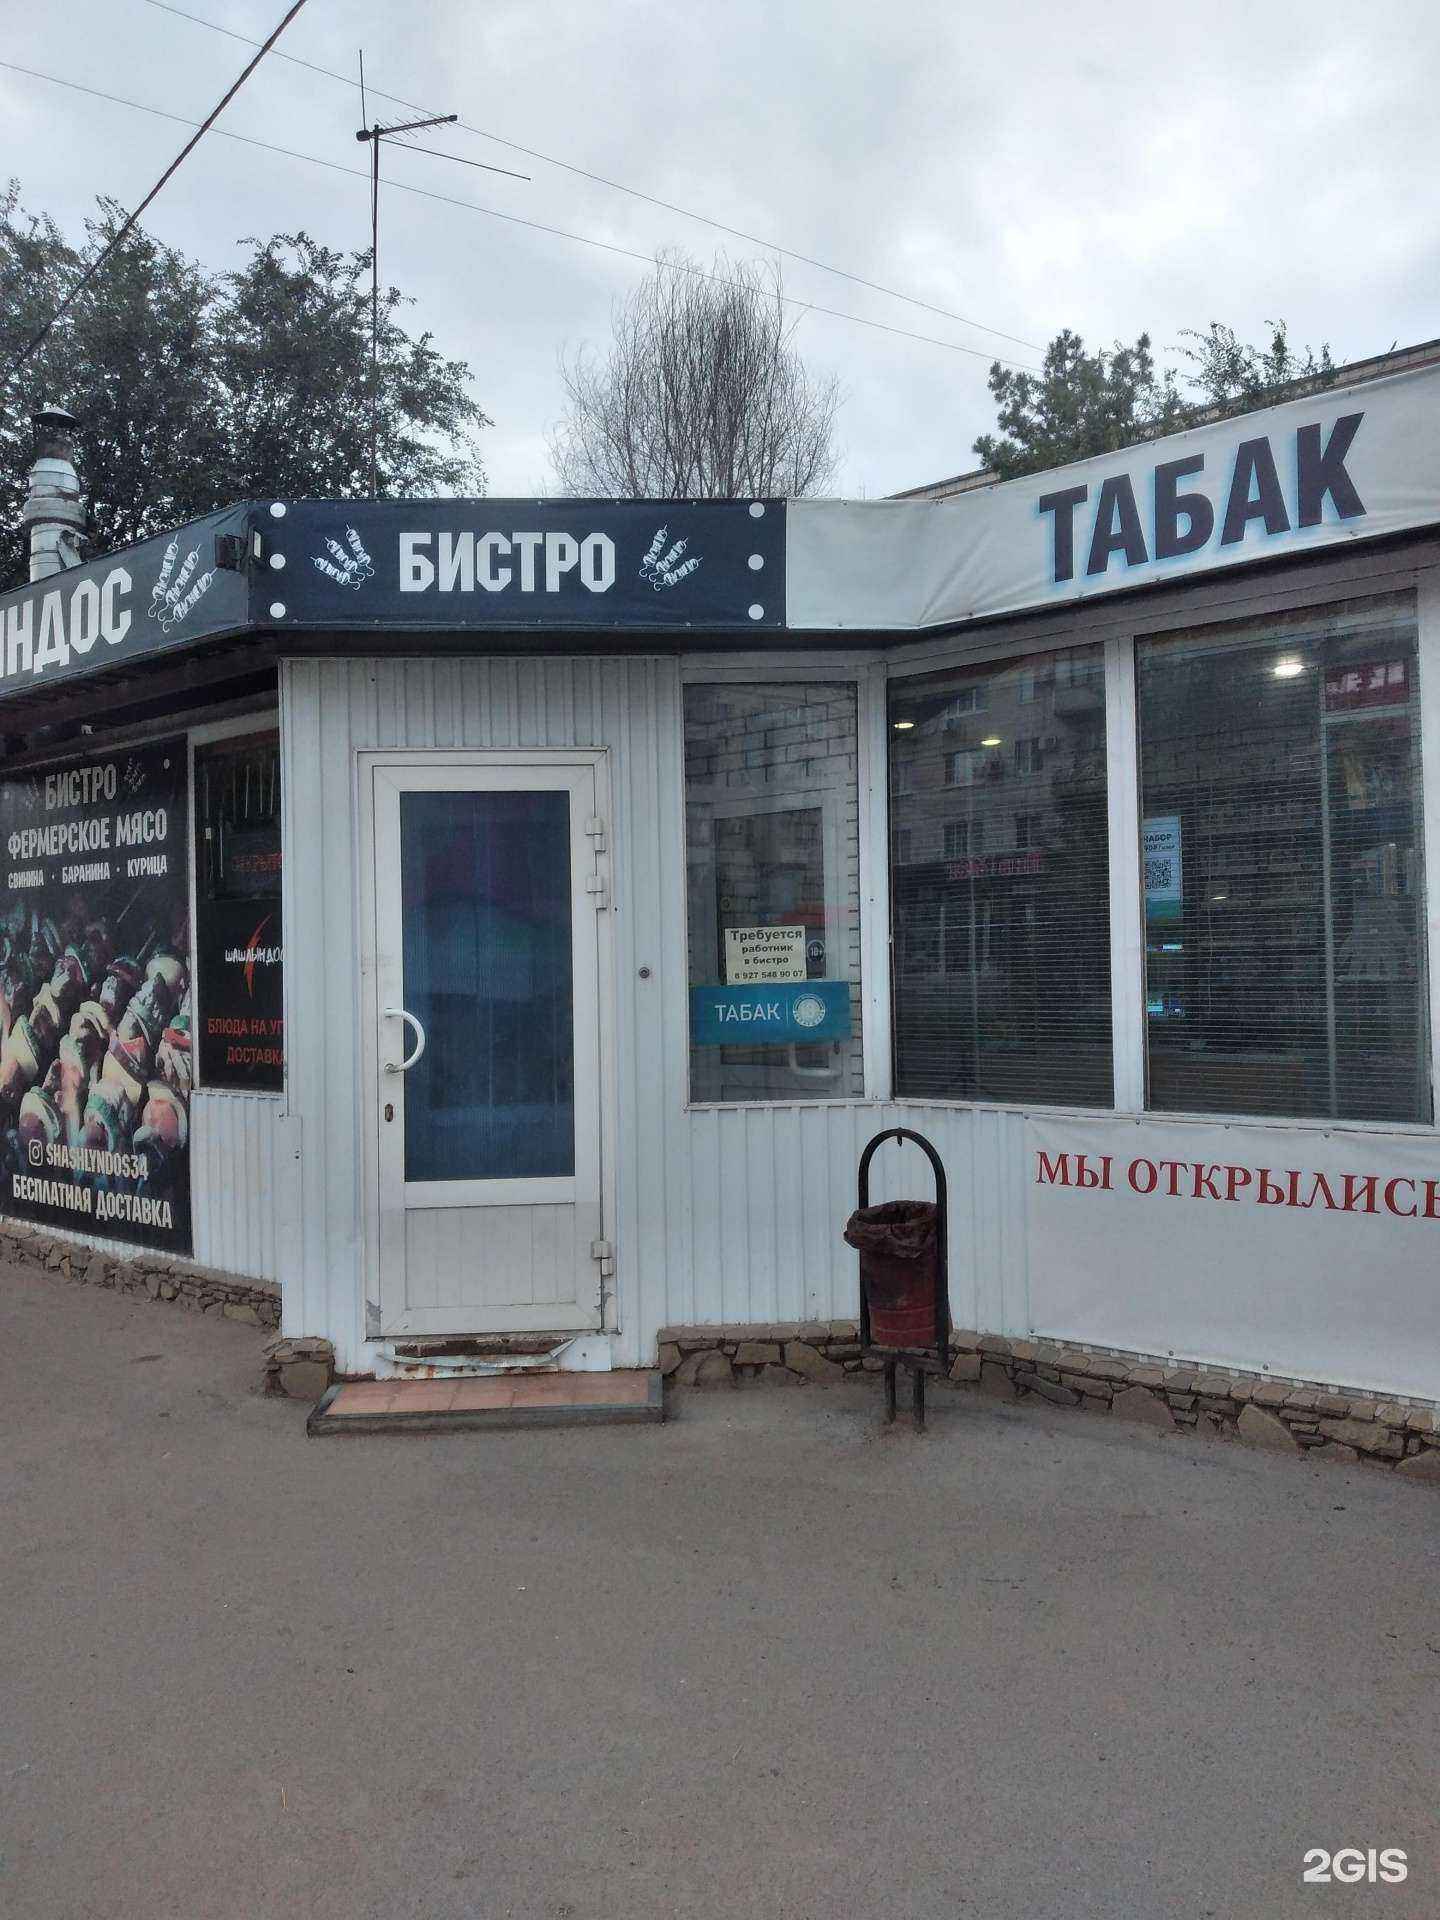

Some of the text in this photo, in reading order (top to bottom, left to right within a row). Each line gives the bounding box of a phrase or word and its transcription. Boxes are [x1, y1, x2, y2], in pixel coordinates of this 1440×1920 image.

[1039, 411, 1367, 583] ТАБАК
[399, 532, 616, 593] БИСТРО
[0, 567, 132, 678] НДОС
[45, 763, 117, 810] БИСТРО
[8, 808, 168, 860] ФЕРМЕРСКОЕ МЯСО
[8, 855, 168, 889] СВИНИНА БАРАНИНА КУРИЦА
[730, 929, 802, 943] Требуется
[742, 944, 793, 954] работник
[743, 972, 758, 980] 927
[753, 956, 789, 965] бистро
[208, 1018, 248, 1037] БЛЮДА
[251, 1020, 266, 1035] НА
[715, 1003, 780, 1022] ТАБАК
[46, 1143, 149, 1181] SHASHLYNDOS34
[1035, 1151, 1115, 1191] МЫ
[12, 1174, 173, 1229] БЕСПЛАТНАЯ ДОСТАВКА
